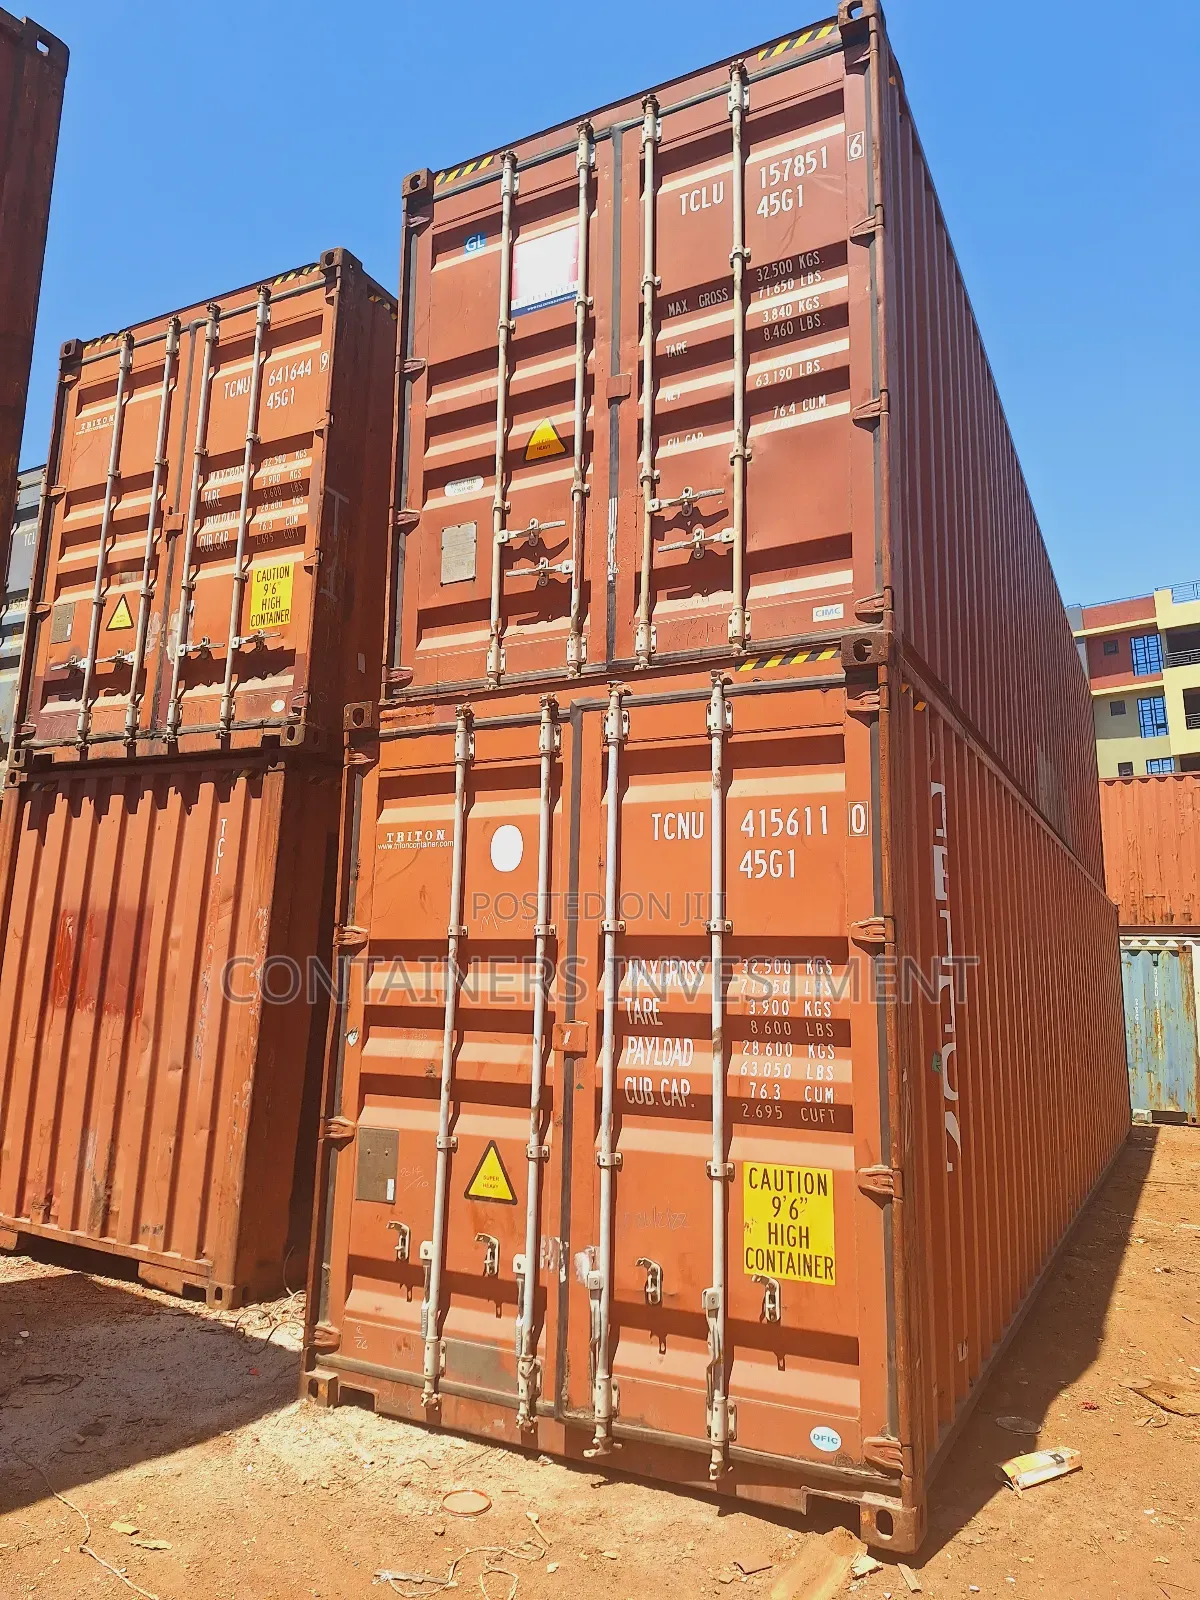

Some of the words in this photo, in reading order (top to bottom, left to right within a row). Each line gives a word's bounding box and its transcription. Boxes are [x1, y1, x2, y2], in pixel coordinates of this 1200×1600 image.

[680, 181, 724, 216] TCLU
[760, 145, 827, 189] 157851
[849, 134, 862, 158] 6
[756, 184, 803, 219] 45G1
[465, 234, 485, 252] GL
[668, 299, 691, 317] MAX.
[698, 287, 729, 308] GROSS
[756, 259, 793, 282] 32.500
[798, 250, 825, 270] KGS.
[758, 277, 795, 299] 71.650
[800, 269, 825, 287] LBS.
[665, 340, 688, 358] TARE
[762, 303, 793, 323] 3.840
[798, 296, 824, 313] KGS.
[763, 320, 794, 341] 8.460
[799, 313, 826, 332] LBS.
[224, 375, 251, 400] TCNU
[268, 358, 312, 387] 641644
[320, 352, 329, 370] 9
[755, 366, 793, 387] 63.190
[799, 359, 824, 377] LBS.
[266, 386, 295, 409] 45G1
[773, 402, 796, 419] 76.4
[204, 488, 222, 509] TARE
[261, 473, 281, 487] 3.900
[257, 565, 290, 583] CAUTION
[262, 596, 281, 611] HIGH
[815, 606, 841, 618] CIMC
[251, 608, 290, 627] CONTAINER
[651, 811, 705, 841] TCNU
[740, 805, 828, 838] 415611
[851, 803, 866, 834] 0
[386, 829, 446, 843] TRITON
[739, 848, 796, 879] 45G1
[741, 959, 791, 975] 32.500
[806, 959, 833, 976] KGS
[624, 997, 664, 1026] TARE
[748, 999, 790, 1016] 3.900
[804, 1000, 832, 1018] KGS
[750, 1020, 792, 1036] 8.600
[806, 1022, 834, 1038] LBS
[625, 1036, 694, 1067] PAYLOAD
[742, 1040, 793, 1057] 28.600
[807, 1044, 835, 1060] KGS
[740, 1060, 792, 1079] 63.050
[806, 1064, 834, 1081] LBS
[749, 1082, 782, 1101] 76.3
[804, 1085, 834, 1104] CUM
[741, 1103, 784, 1120] 2.695
[800, 1107, 835, 1124] CUFT
[748, 1167, 828, 1197] CAUTION
[768, 1222, 809, 1249] HIGH
[745, 1247, 834, 1280] CONTAINER
[813, 1433, 839, 1445] DFIC
